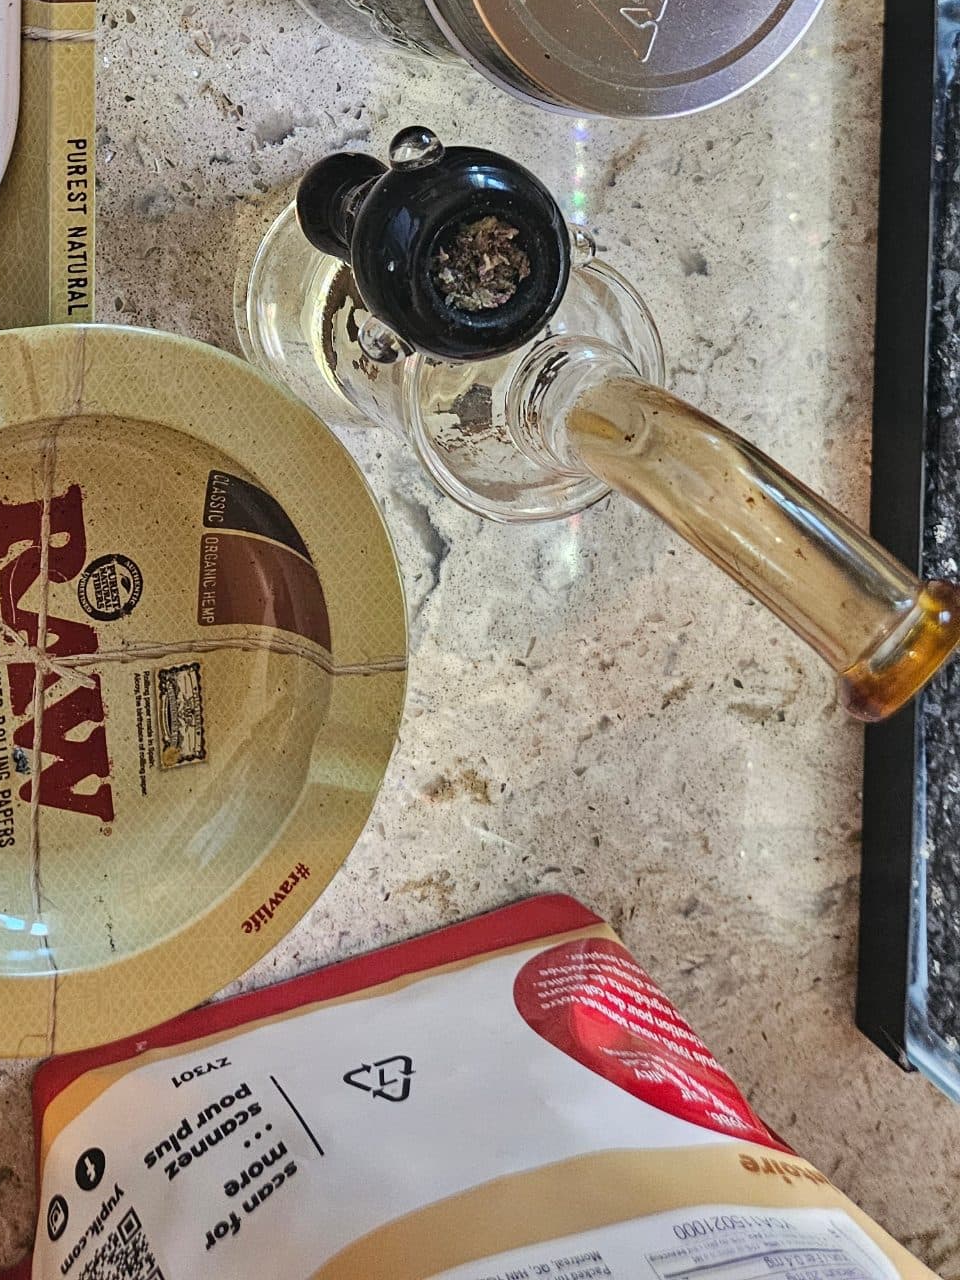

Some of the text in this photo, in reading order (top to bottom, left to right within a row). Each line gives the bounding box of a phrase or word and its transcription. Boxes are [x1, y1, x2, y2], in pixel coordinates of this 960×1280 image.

[66, 138, 88, 316] PUREST NATURAL
[208, 473, 230, 523] CLASSIC
[79, 571, 93, 613] UNREFINED
[92, 572, 105, 609] FIBERS
[99, 567, 113, 612] NATURAL
[106, 564, 121, 608] PUREST
[124, 560, 141, 606] AUTHENTIC
[201, 536, 220, 624] ORGANIC HEMP
[241, 862, 311, 934] #rawlife
[171, 1057, 232, 1089] ZY301
[144, 1082, 253, 1169] pour plus
[164, 1101, 263, 1181] scannez
[224, 1141, 288, 1197] more
[60, 1182, 125, 1276] yupik.com
[205, 1160, 298, 1251] scan for
